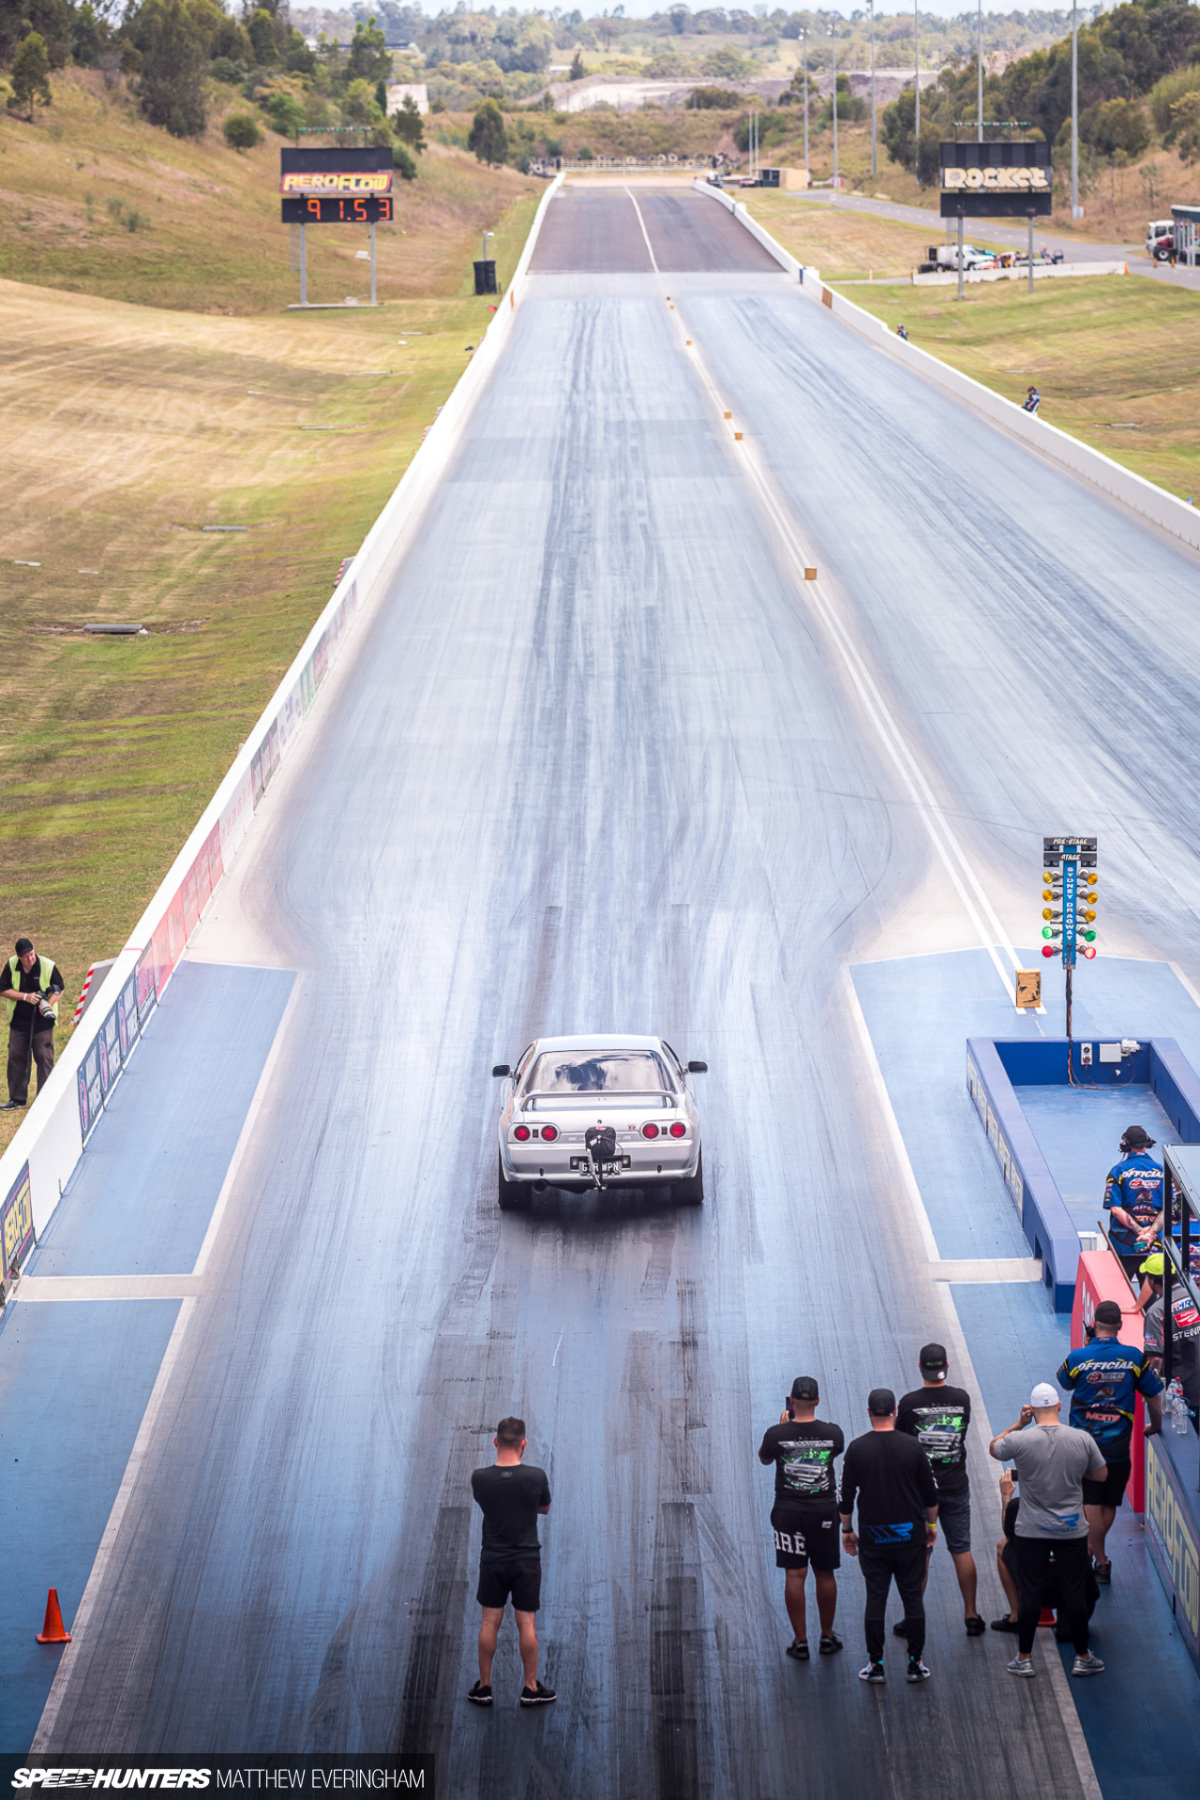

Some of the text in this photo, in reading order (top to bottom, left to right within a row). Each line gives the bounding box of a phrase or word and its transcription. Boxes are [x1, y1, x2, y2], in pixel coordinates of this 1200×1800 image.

[283, 174, 389, 191] AEROFLOW
[1060, 853, 1081, 861] STAGE
[1065, 867, 1075, 940] SYDNEY DRAGWAY
[1077, 1361, 1134, 1371] OFFICIAL
